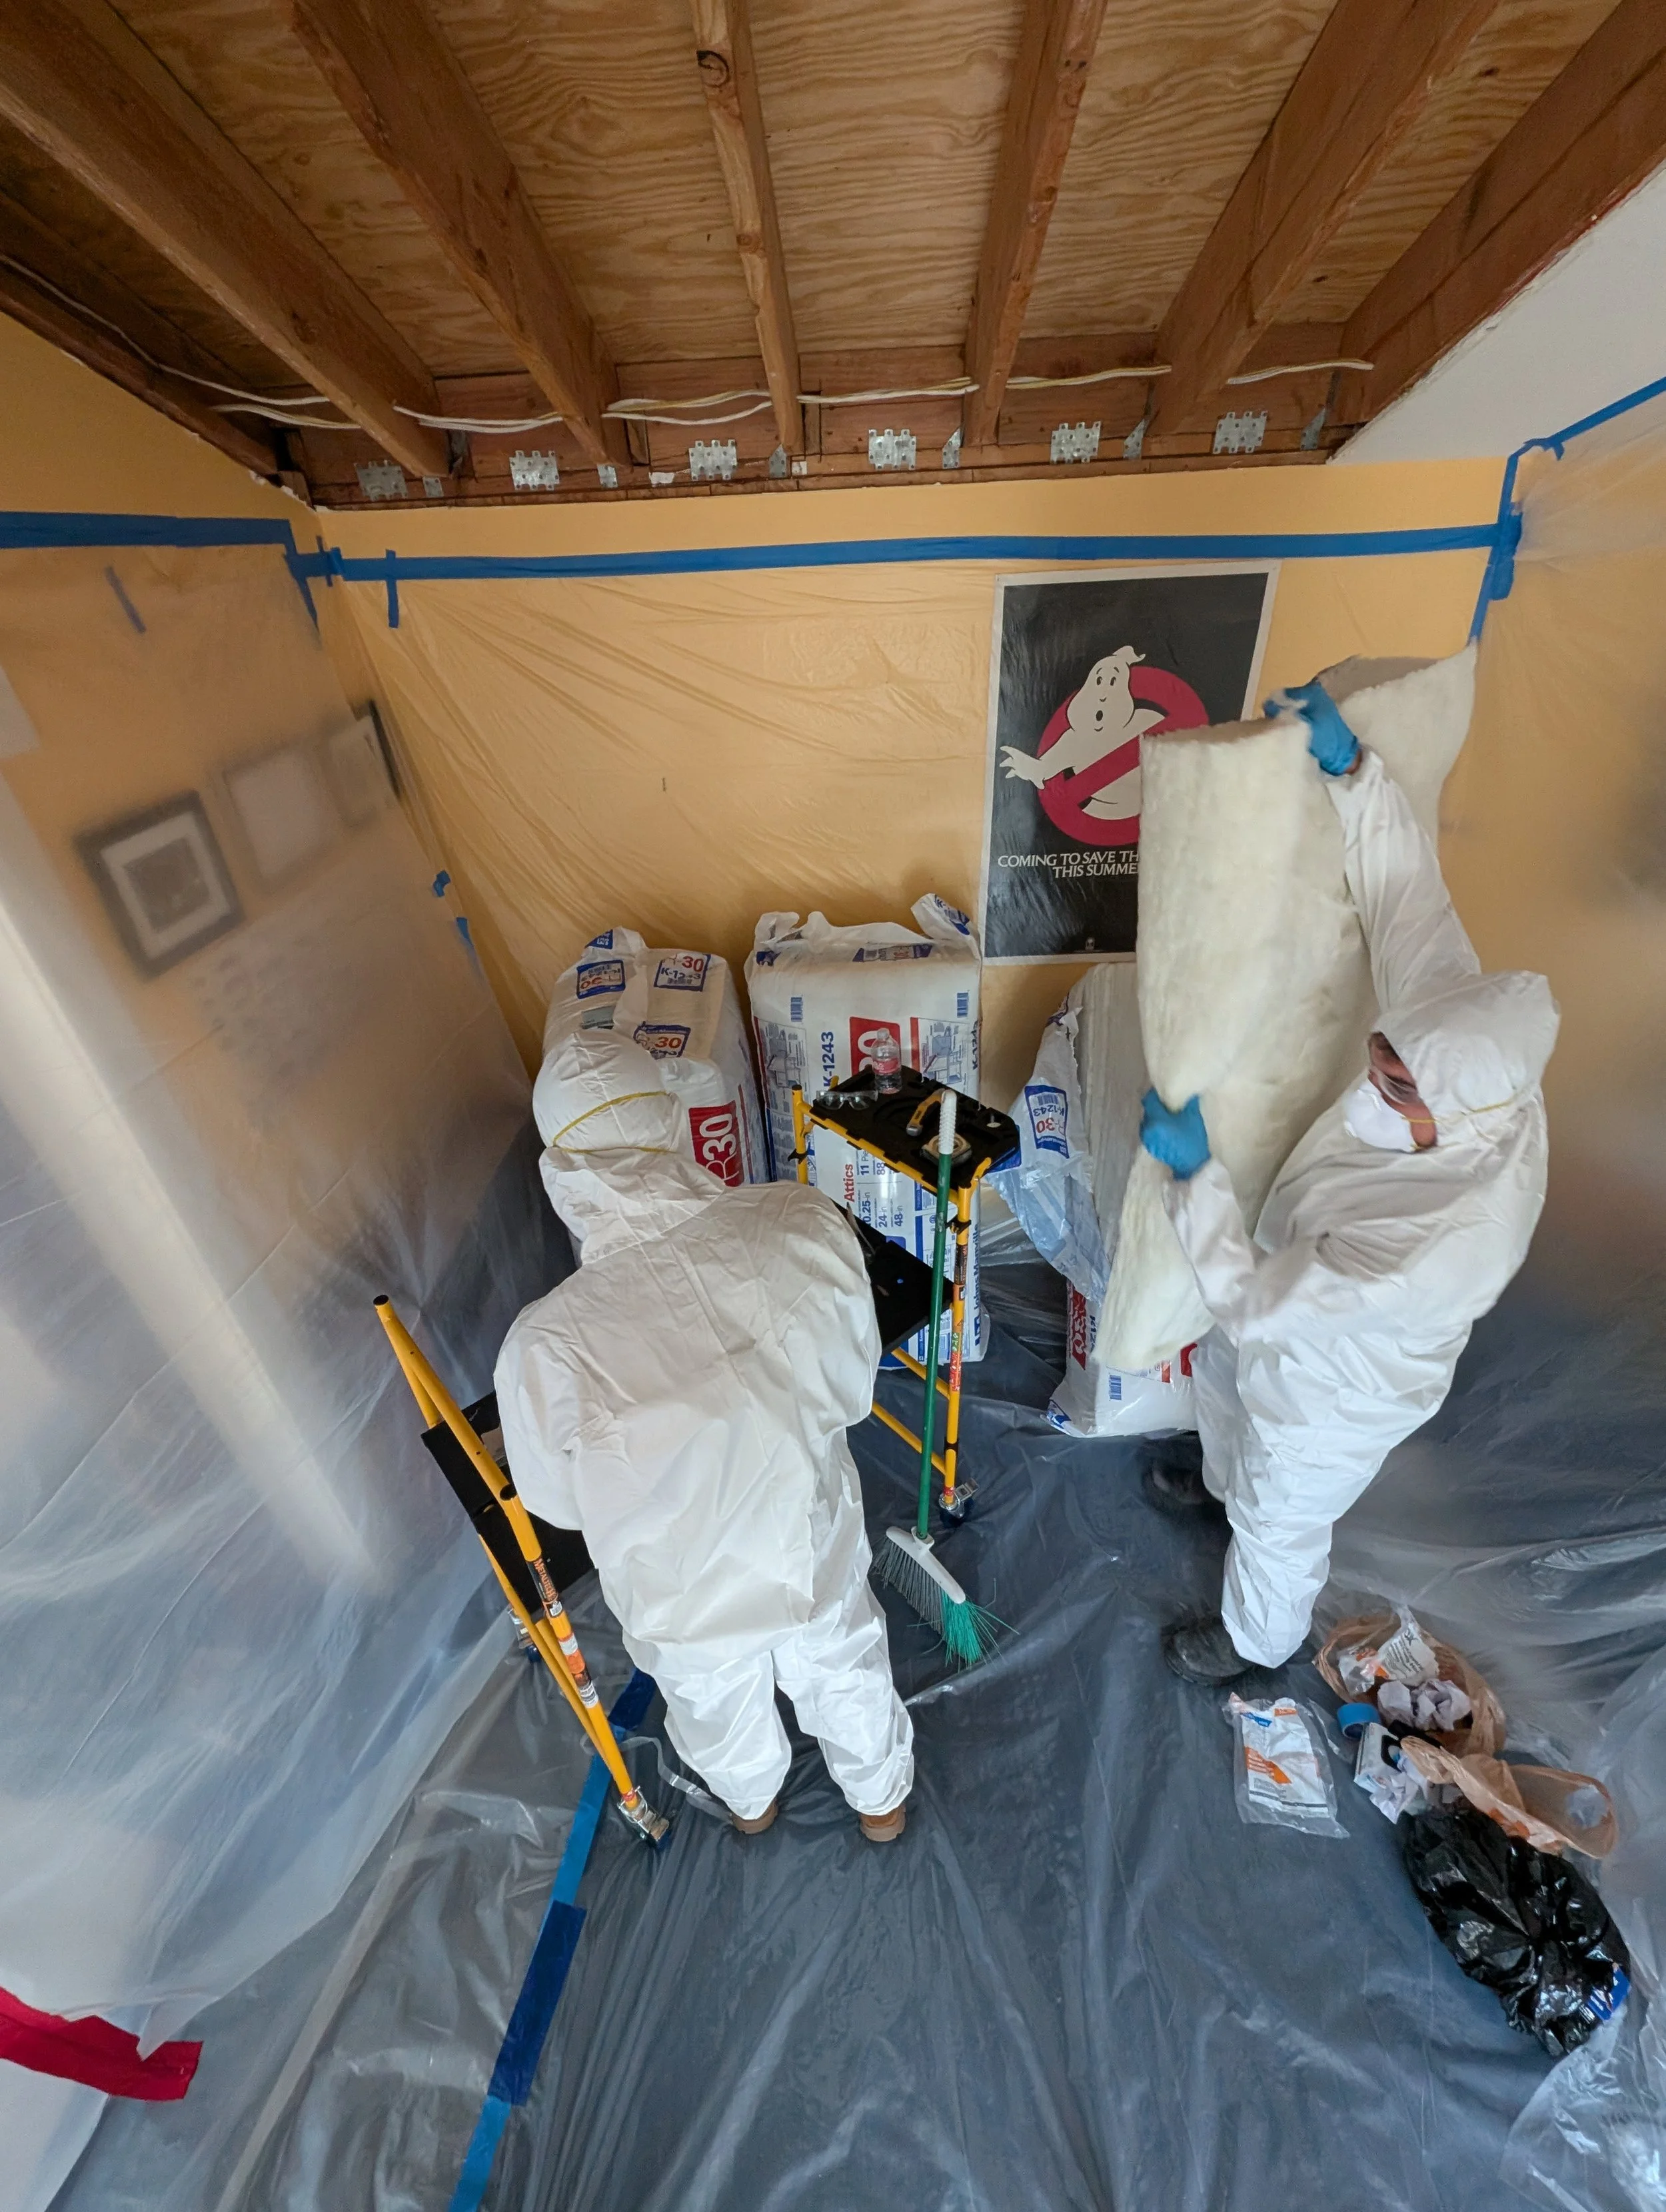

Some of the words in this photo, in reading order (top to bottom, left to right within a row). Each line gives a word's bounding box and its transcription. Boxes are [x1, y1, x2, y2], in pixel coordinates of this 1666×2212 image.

[998, 853, 1058, 867] COMING
[1060, 852, 1081, 865] TO
[1082, 851, 1116, 864] SAVE
[1052, 865, 1084, 878] THIS
[1086, 863, 1139, 877] SUMME
[820, 1031, 835, 1087] K-1243
[860, 1165, 870, 1175] 11
[876, 1161, 886, 1176] 88
[843, 1163, 855, 1203] Attics
[862, 1192, 872, 1227] 0.25-in
[878, 1206, 888, 1228] 24-in
[894, 1205, 904, 1227] 48-in
